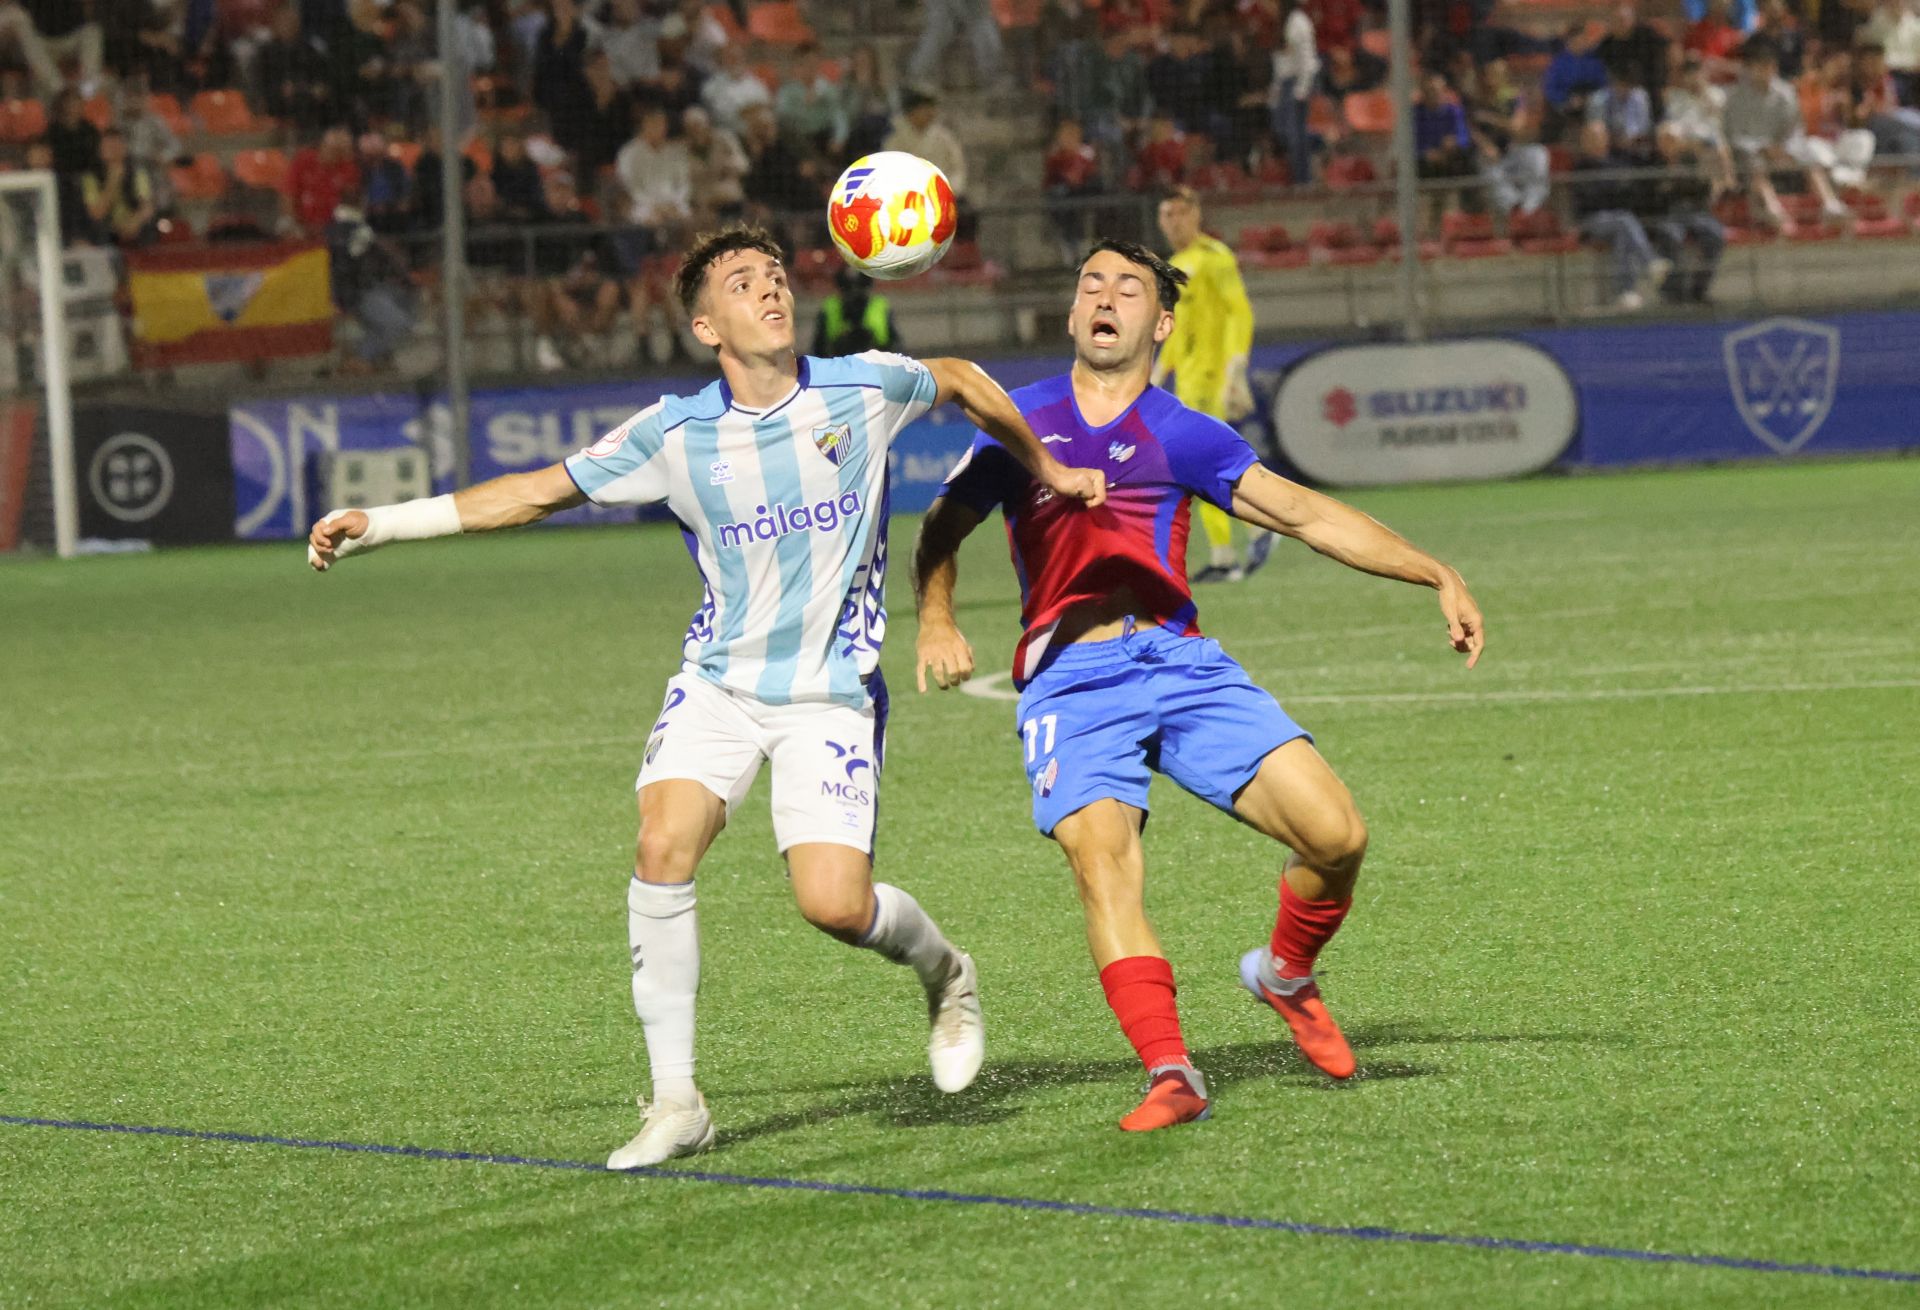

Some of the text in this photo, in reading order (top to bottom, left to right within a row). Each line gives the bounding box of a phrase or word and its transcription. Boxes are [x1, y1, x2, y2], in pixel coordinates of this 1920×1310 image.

[1369, 384, 1526, 417] SUZUKI
[1023, 714, 1057, 763] 11
[821, 781, 869, 806] MGS
